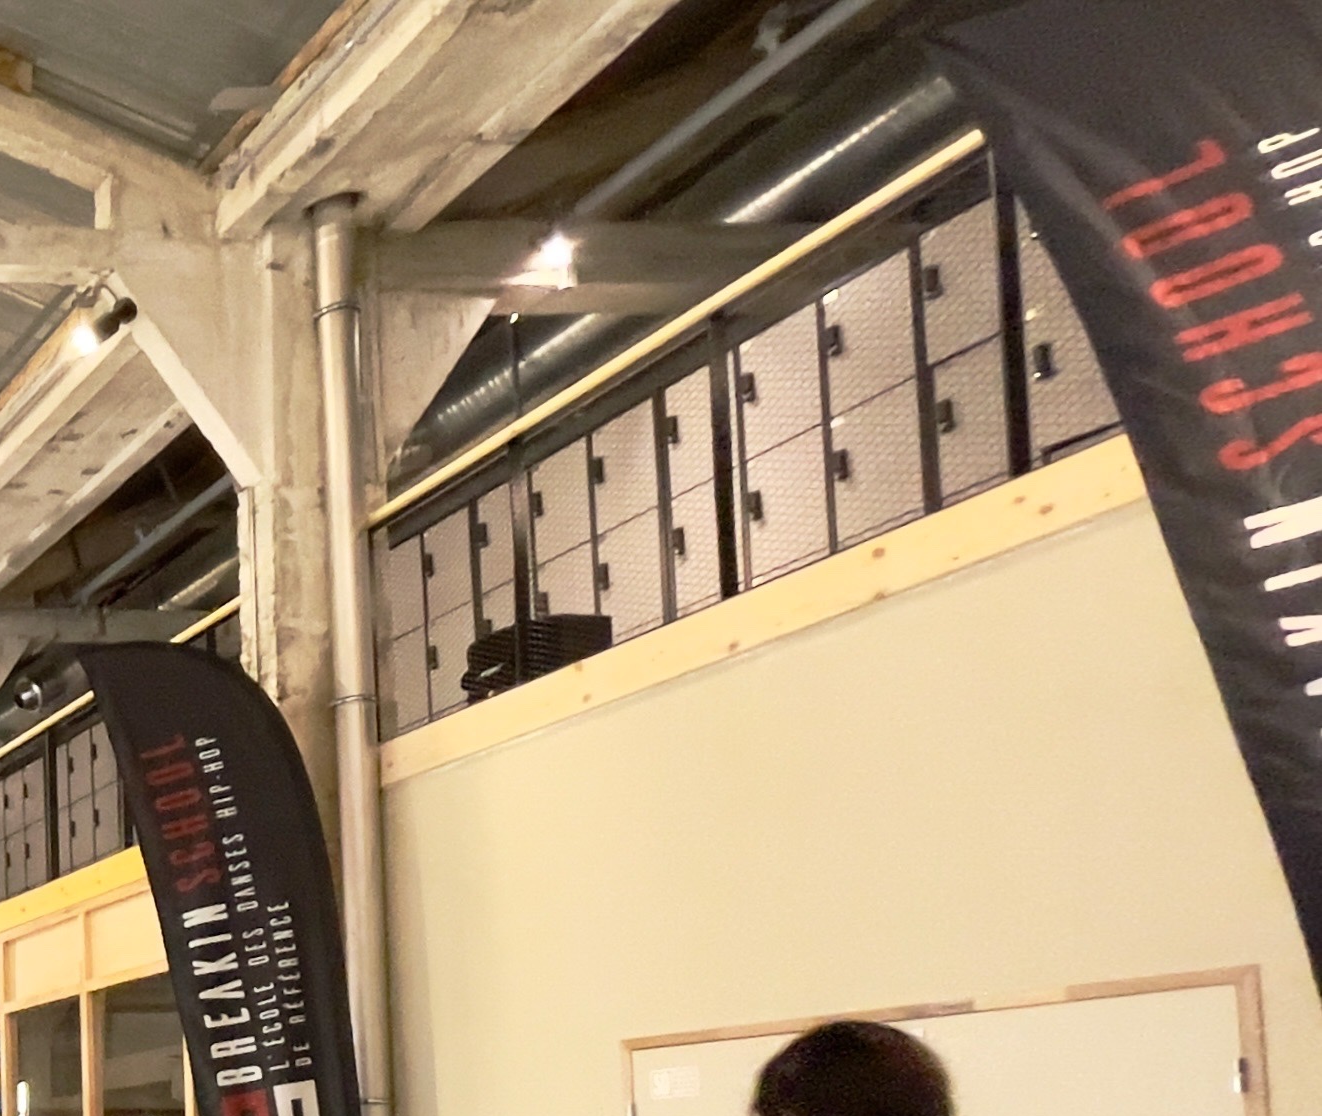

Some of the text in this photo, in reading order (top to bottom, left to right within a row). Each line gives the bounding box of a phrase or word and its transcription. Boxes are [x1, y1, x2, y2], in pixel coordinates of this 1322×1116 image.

[222, 833, 258, 912] DANSES
[140, 734, 263, 1087] BREAKIN SCHOOL
[242, 928, 270, 967] DES
[292, 1043, 312, 1067] DE
